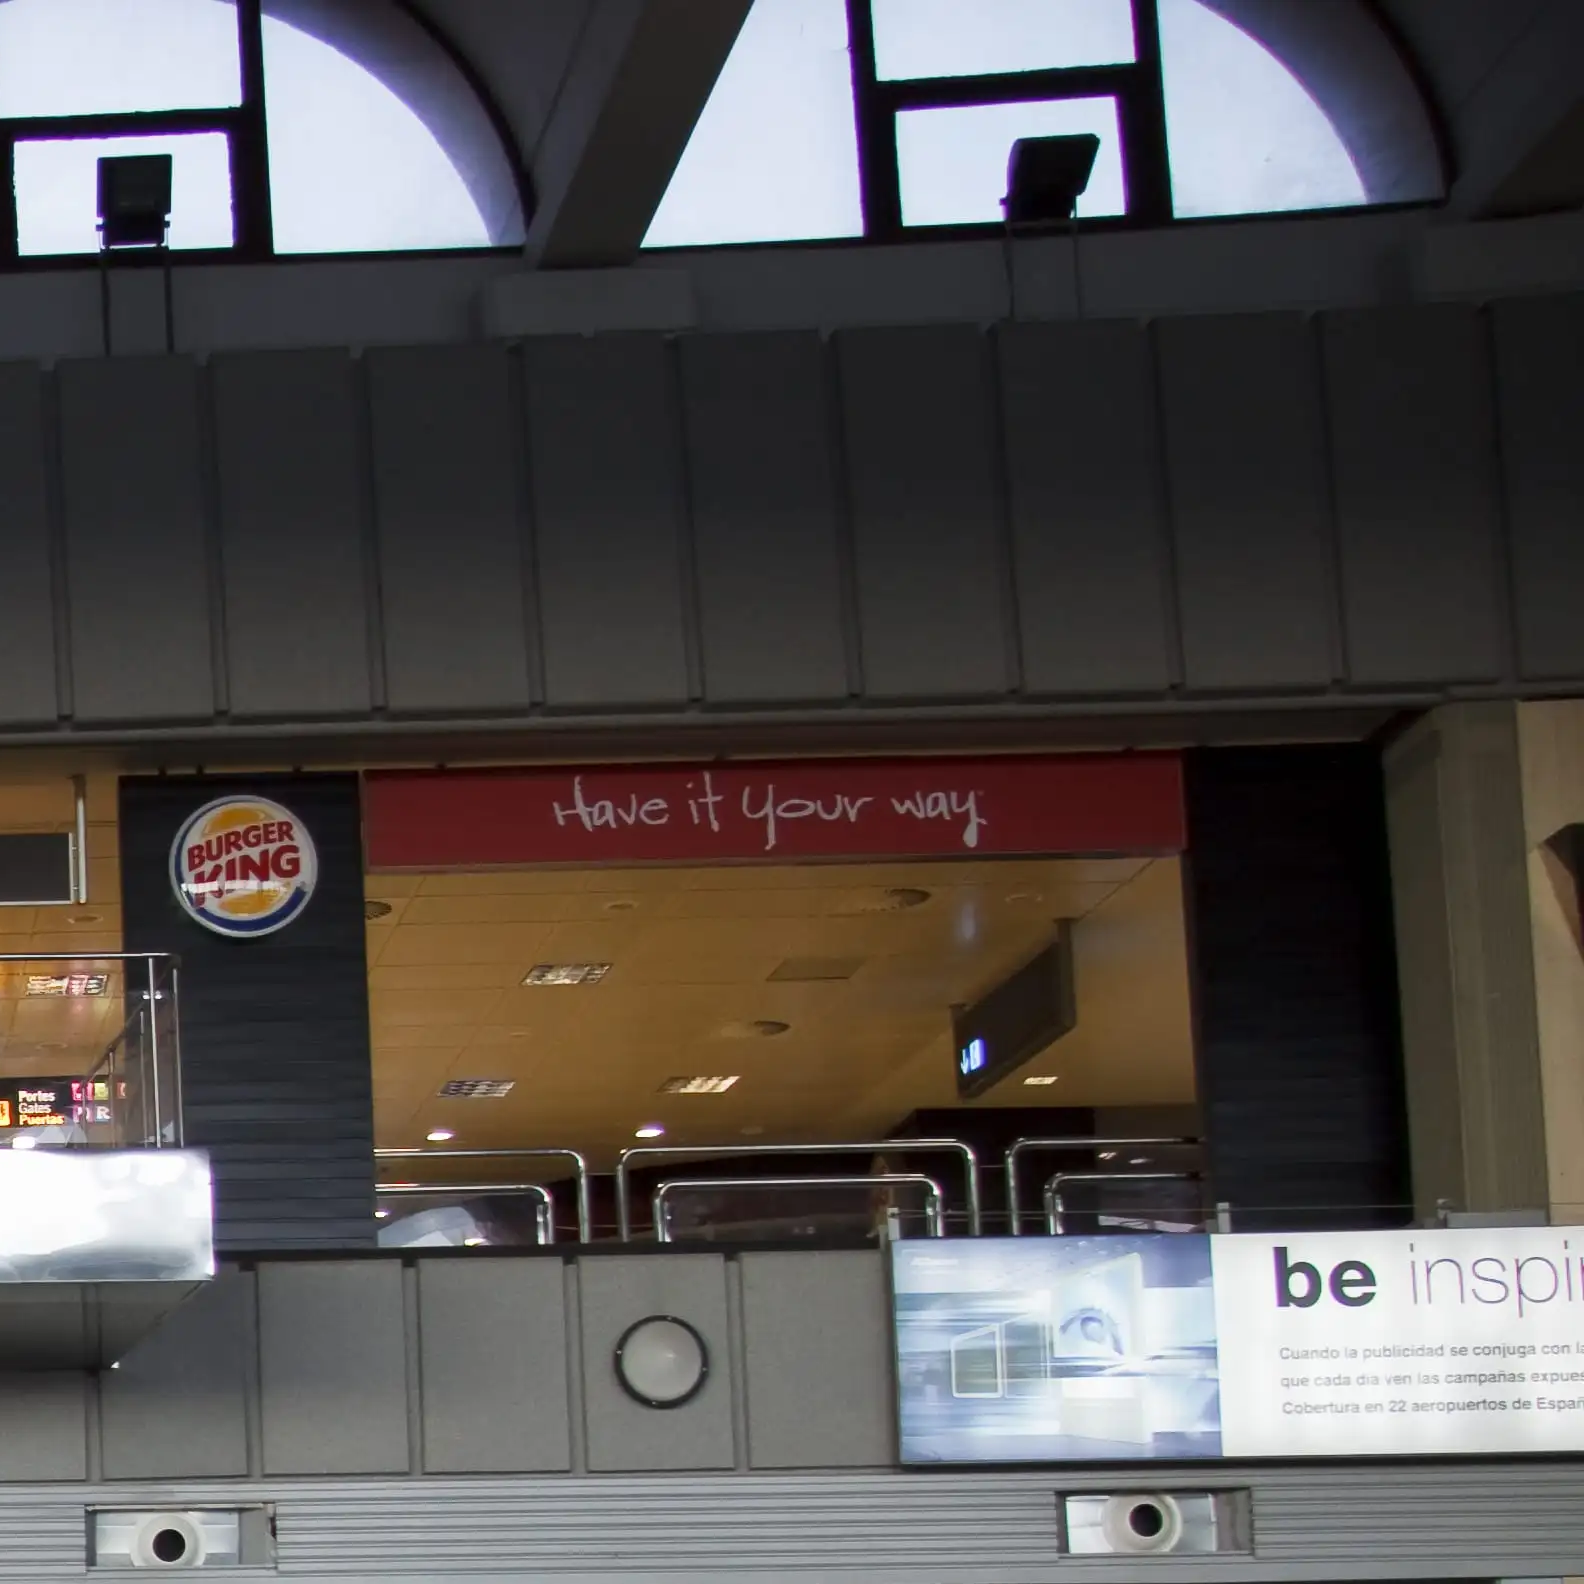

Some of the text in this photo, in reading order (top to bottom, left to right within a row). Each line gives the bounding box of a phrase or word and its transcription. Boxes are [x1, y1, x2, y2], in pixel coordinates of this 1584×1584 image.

[552, 775, 670, 832] Have
[687, 771, 723, 833] it
[891, 790, 987, 847] way
[187, 820, 295, 872] BURGER
[194, 845, 301, 908] KING
[18, 1090, 56, 1102] Portes
[18, 1103, 52, 1114] Gates
[18, 1114, 65, 1126] Puertas
[1273, 1246, 1377, 1309] be
[1279, 1347, 1339, 1360] Cuando
[1344, 1347, 1358, 1359] la
[1362, 1344, 1444, 1362] publicidad
[1450, 1345, 1468, 1357] se
[1473, 1344, 1536, 1362] conjuga
[1541, 1344, 1570, 1356] con
[1281, 1376, 1309, 1389] que
[1314, 1374, 1351, 1387] cada
[1384, 1373, 1412, 1385] ven
[1418, 1372, 1439, 1385] las
[1445, 1371, 1525, 1387] campañas
[1282, 1401, 1360, 1415] Cobertura
[1365, 1402, 1383, 1414] en
[1388, 1400, 1408, 1413] 22
[1412, 1398, 1507, 1416] aeropuertos
[1511, 1397, 1531, 1411] de
